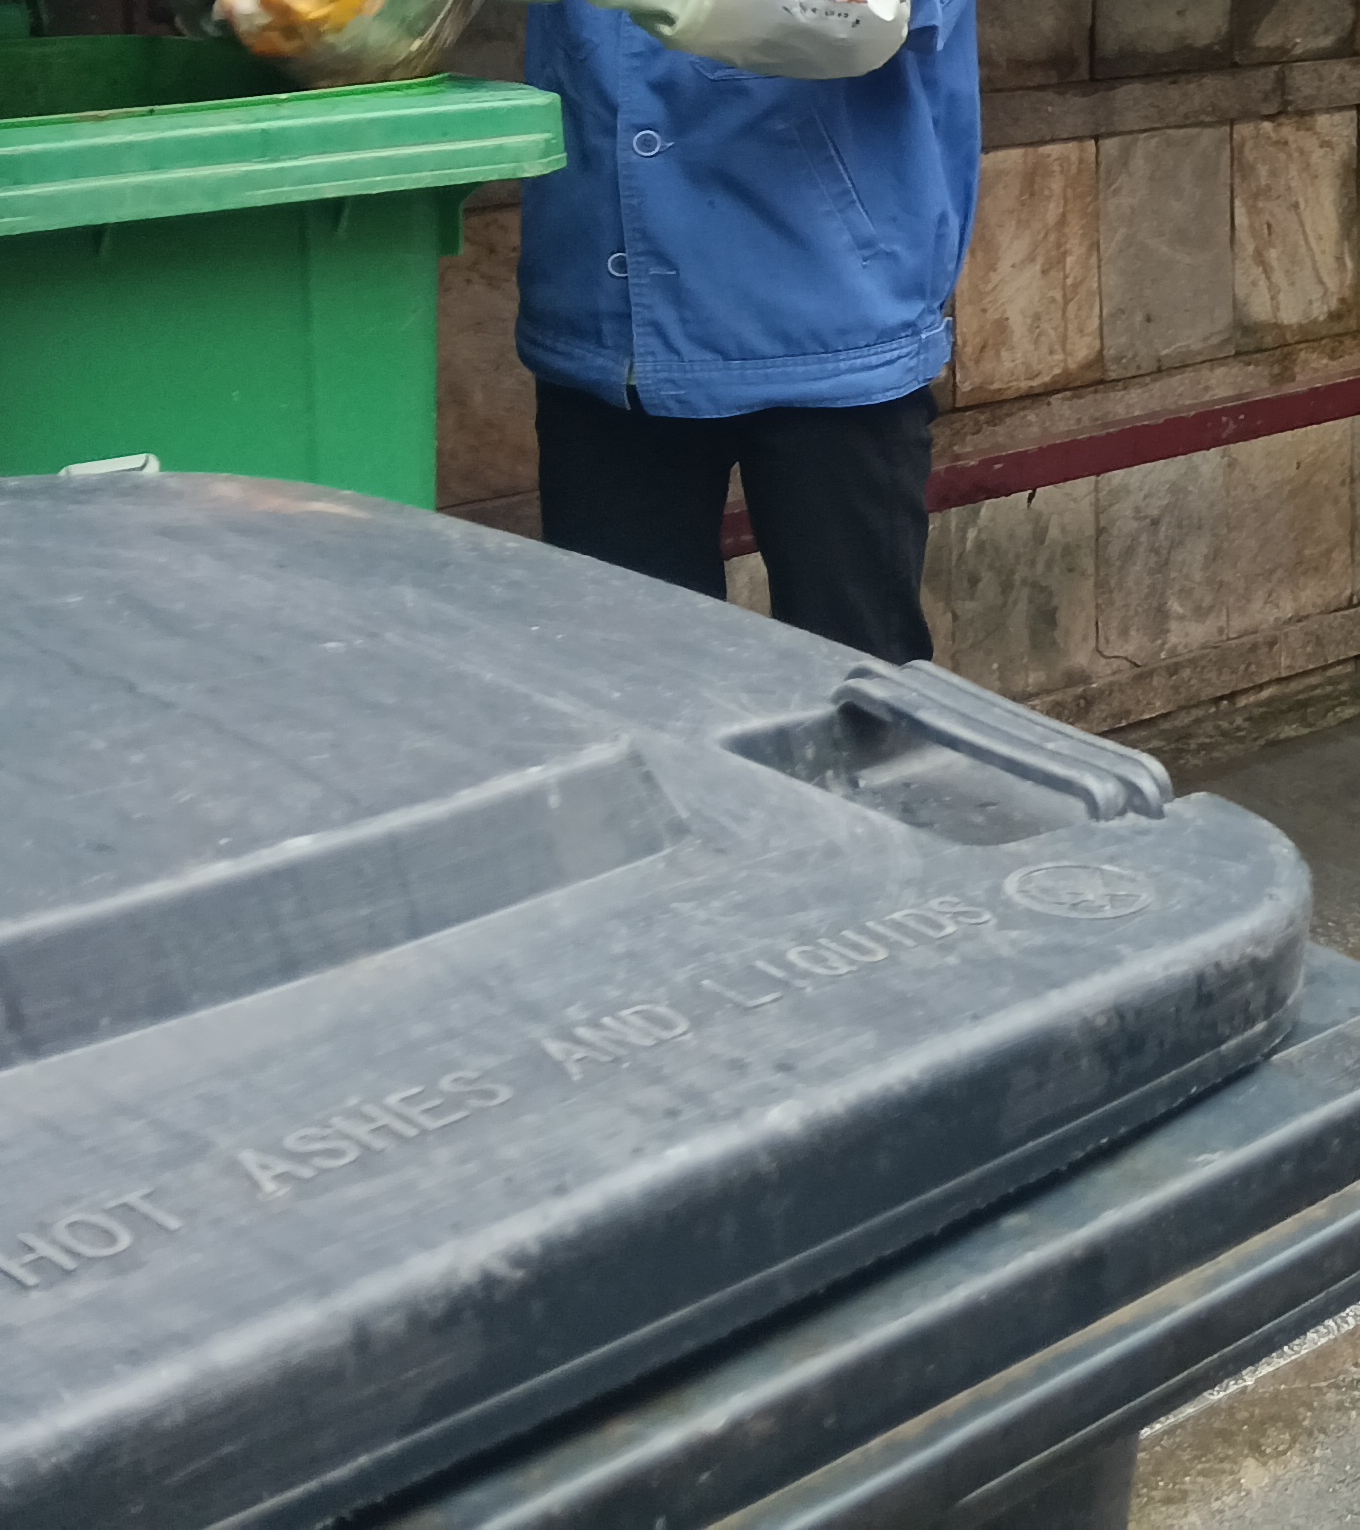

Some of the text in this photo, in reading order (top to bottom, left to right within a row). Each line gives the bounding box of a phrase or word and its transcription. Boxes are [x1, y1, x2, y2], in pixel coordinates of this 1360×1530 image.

[0, 892, 994, 1286] HOT ASHES AND LIQUIDS
